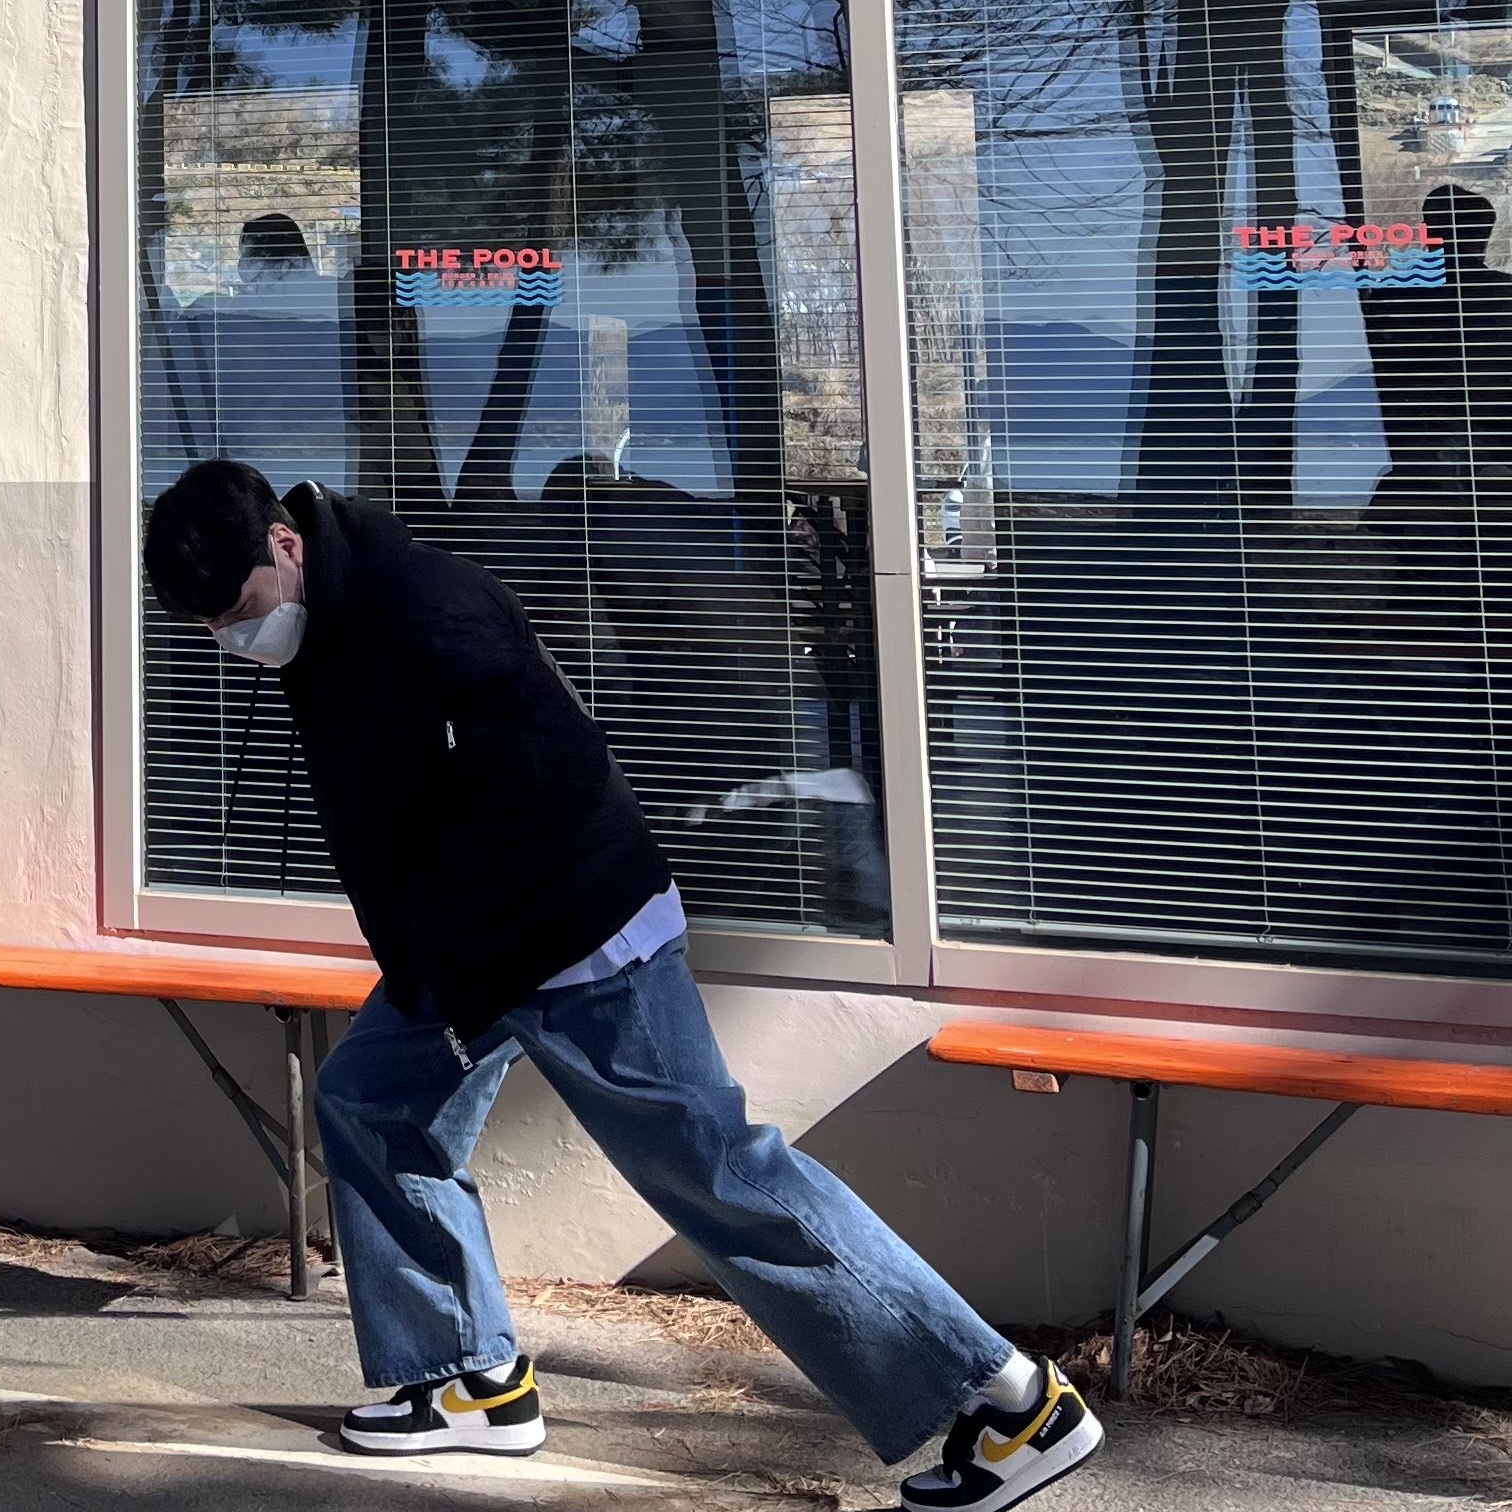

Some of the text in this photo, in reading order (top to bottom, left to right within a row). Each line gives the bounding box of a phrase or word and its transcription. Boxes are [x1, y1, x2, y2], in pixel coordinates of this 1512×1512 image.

[1232, 222, 1444, 249] THE POOL
[395, 248, 562, 270] THE POOL
